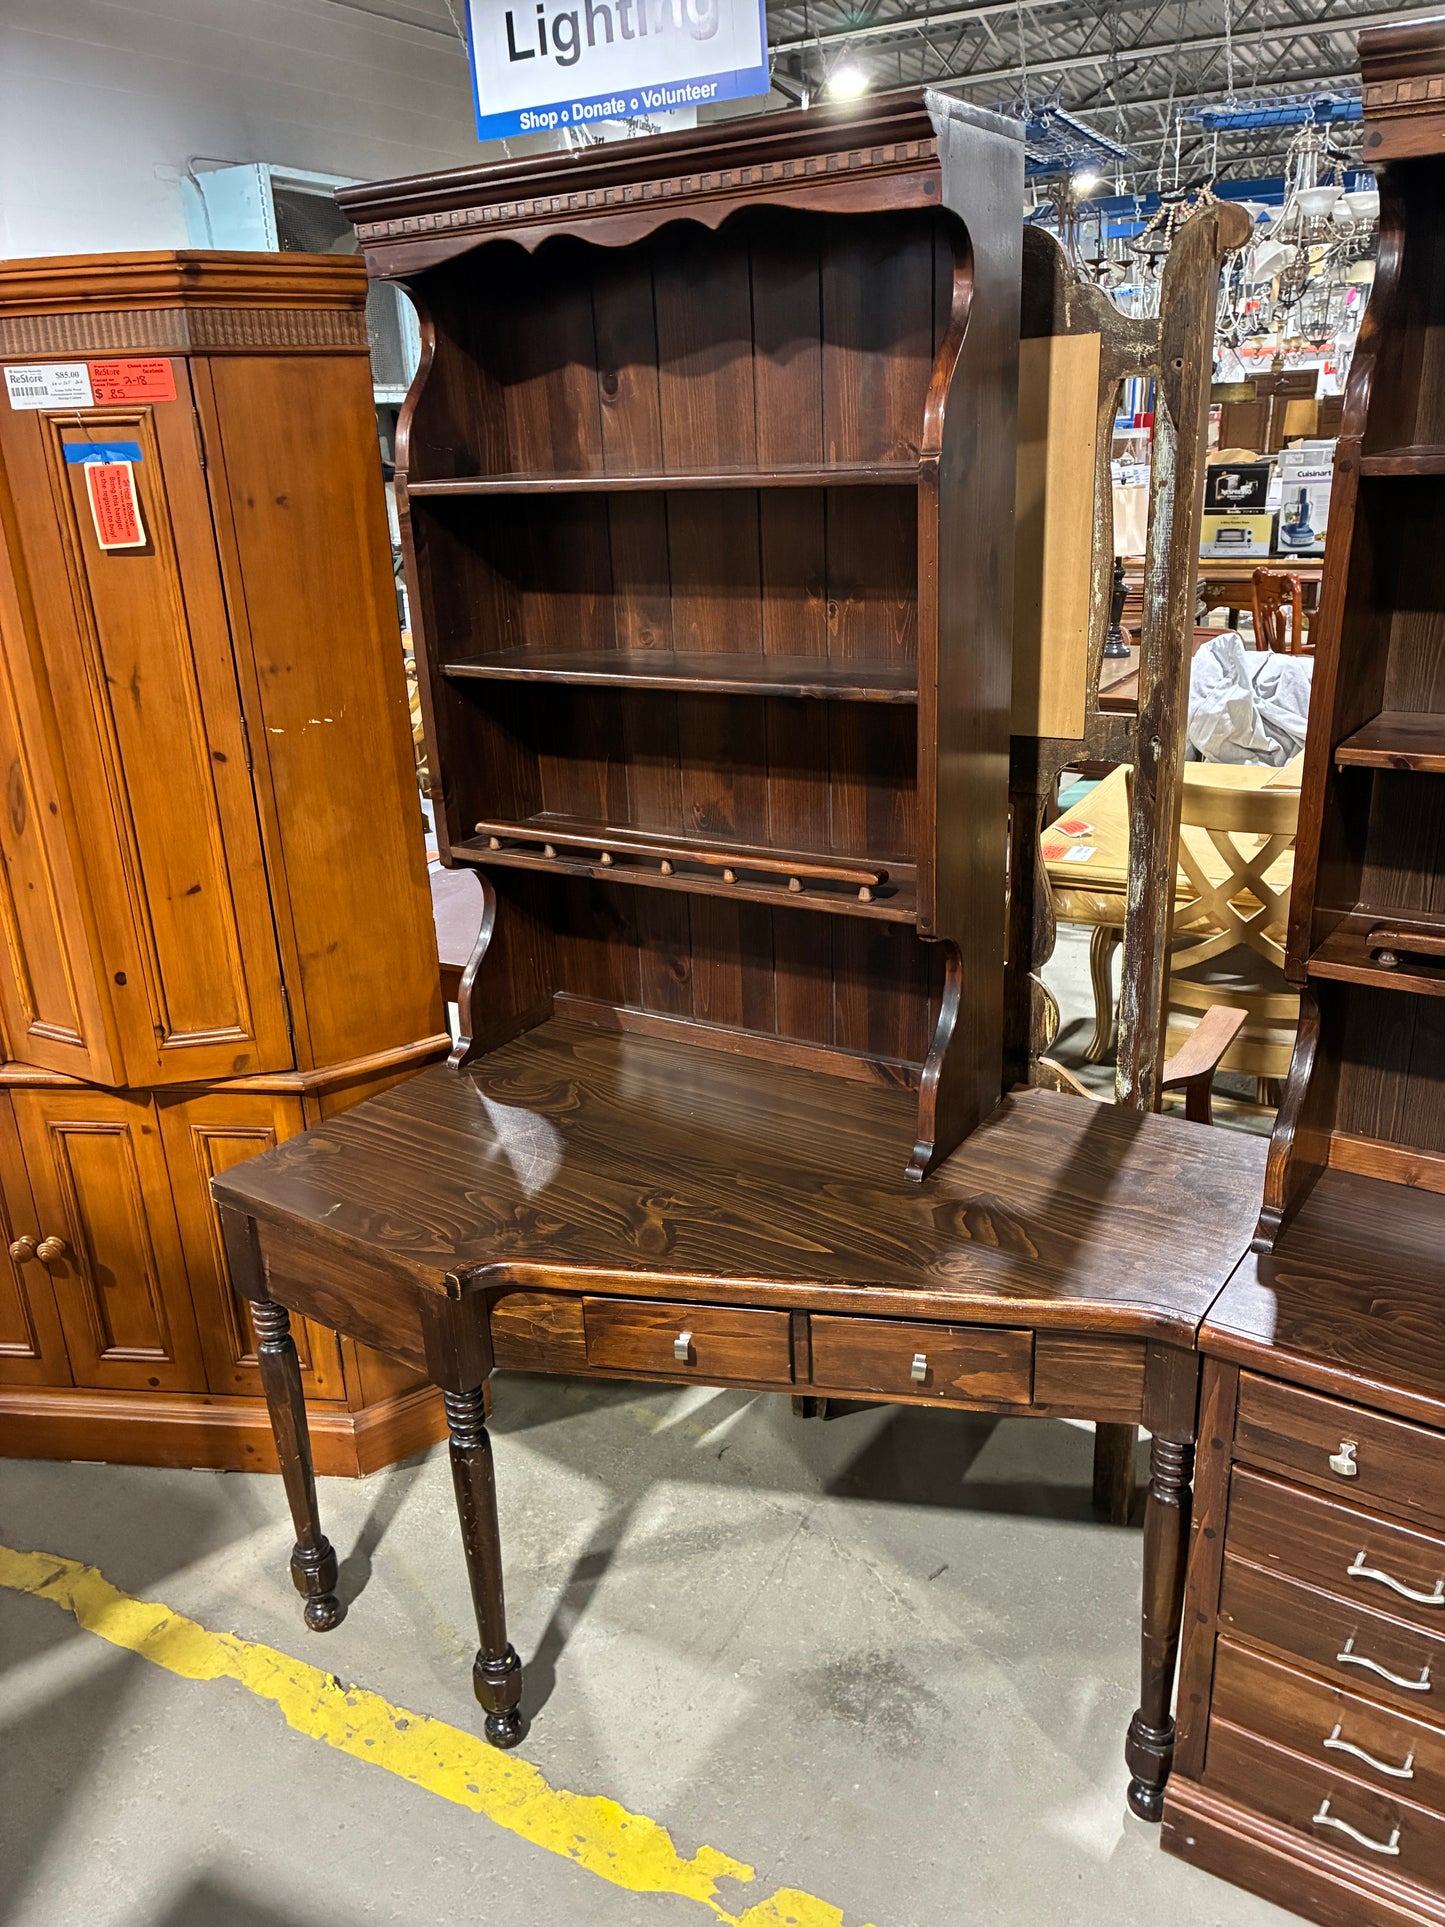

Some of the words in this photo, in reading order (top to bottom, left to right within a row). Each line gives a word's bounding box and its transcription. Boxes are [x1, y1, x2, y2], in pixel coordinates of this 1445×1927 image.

[520, 111, 558, 130] Shop
[572, 97, 626, 121] Donate
[641, 82, 718, 108] Volunteer
[10, 374, 43, 384] ReStore
[95, 388, 103, 399] $
[110, 389, 125, 398] 85
[1297, 470, 1332, 478] Cuisinart
[102, 491, 111, 514] register
[115, 508, 123, 530] hanger
